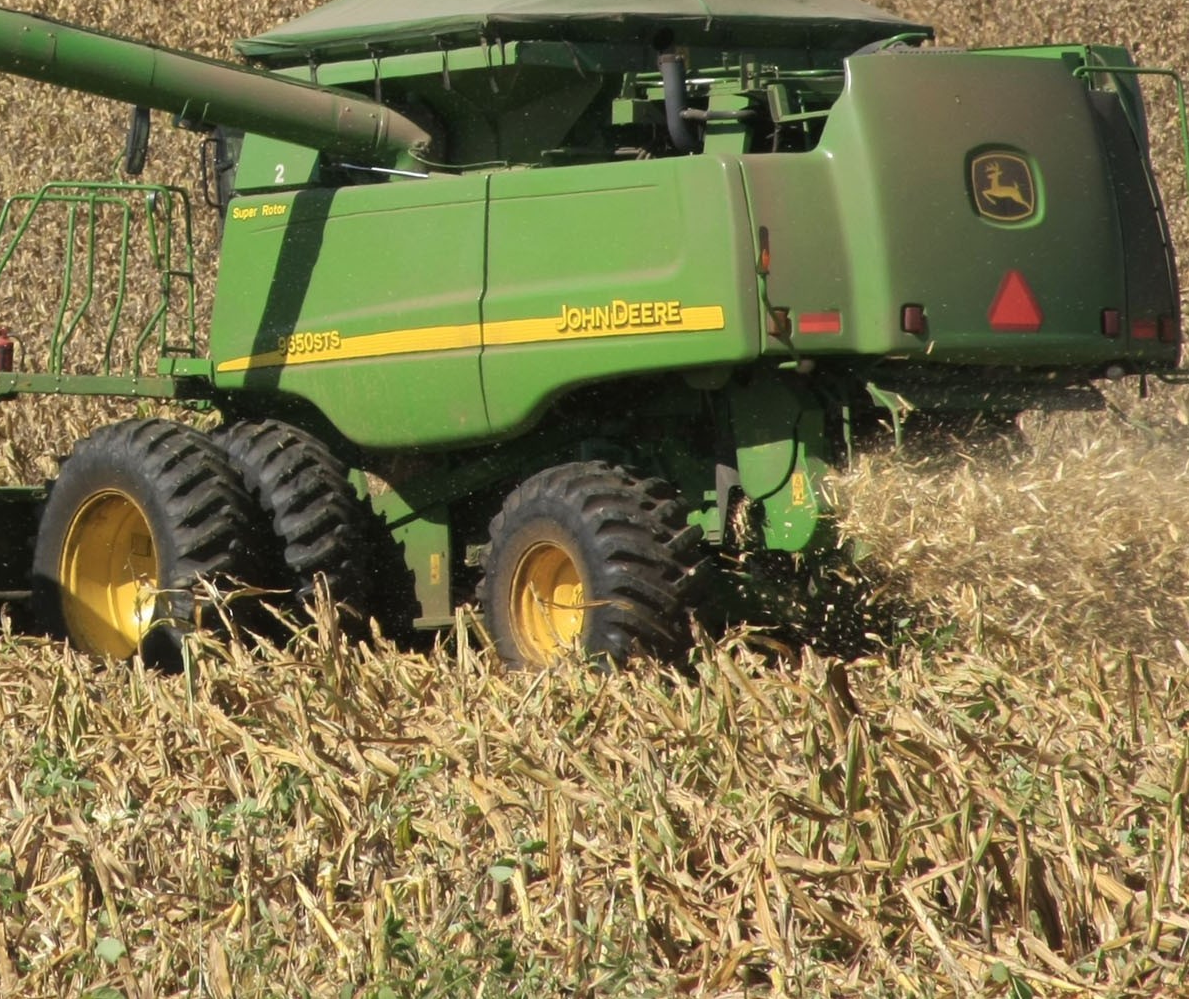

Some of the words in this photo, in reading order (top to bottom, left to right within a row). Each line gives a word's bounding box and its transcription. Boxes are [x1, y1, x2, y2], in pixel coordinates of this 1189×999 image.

[274, 163, 285, 184] 2
[232, 207, 258, 221] Super
[261, 204, 287, 217] Rotor
[278, 330, 340, 354] 9650STS
